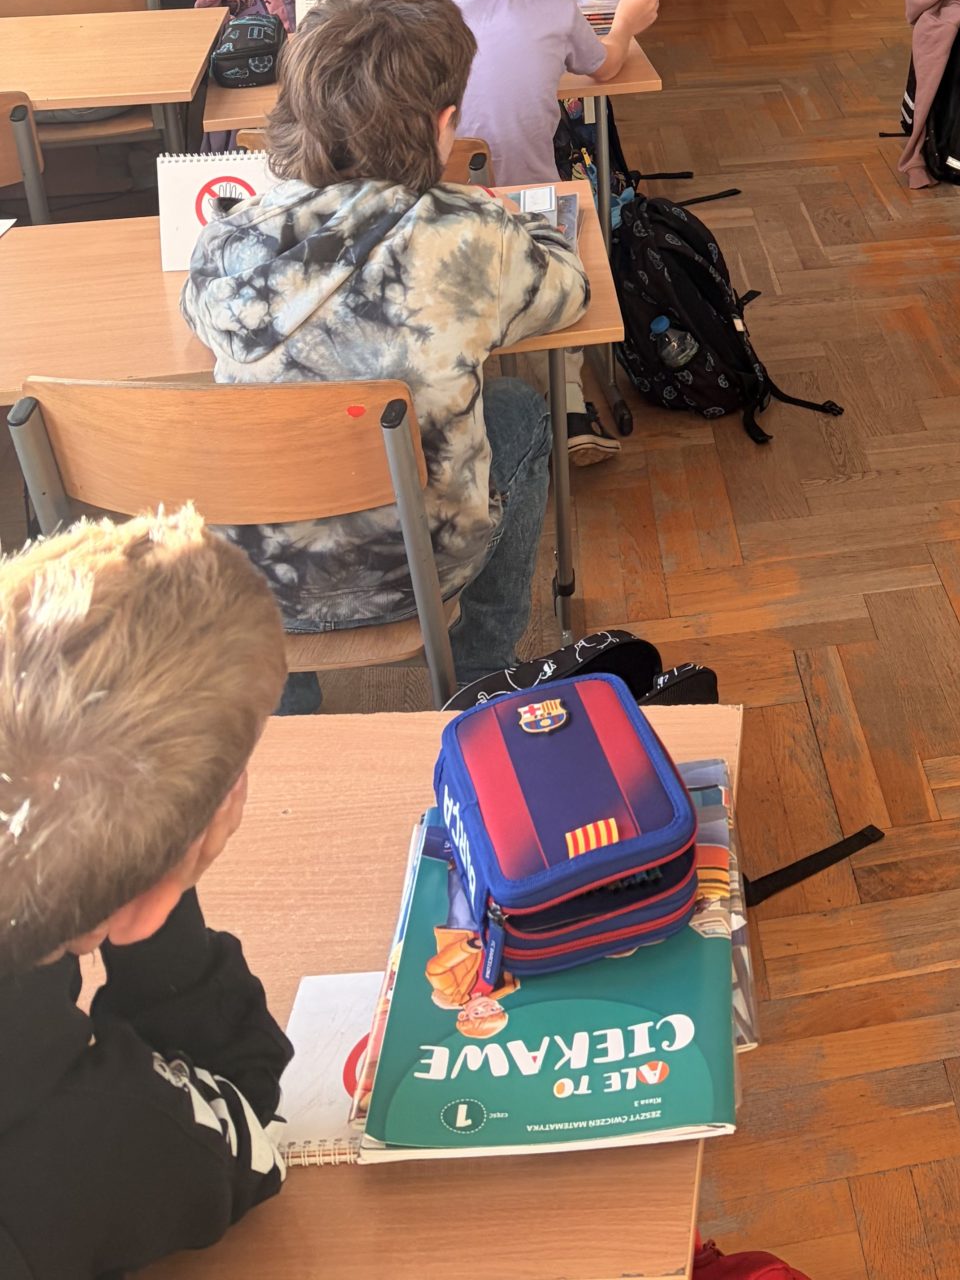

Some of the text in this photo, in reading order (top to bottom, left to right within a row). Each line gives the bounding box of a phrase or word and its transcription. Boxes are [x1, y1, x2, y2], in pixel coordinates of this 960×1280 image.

[414, 1014, 695, 1080] CIEKAWE
[553, 1061, 662, 1098] ALE TO
[642, 1097, 661, 1105] Klasa
[456, 1104, 472, 1127] 1
[526, 1110, 661, 1132] ZESZYT ĆWICZEŃ MATEMATYKA
